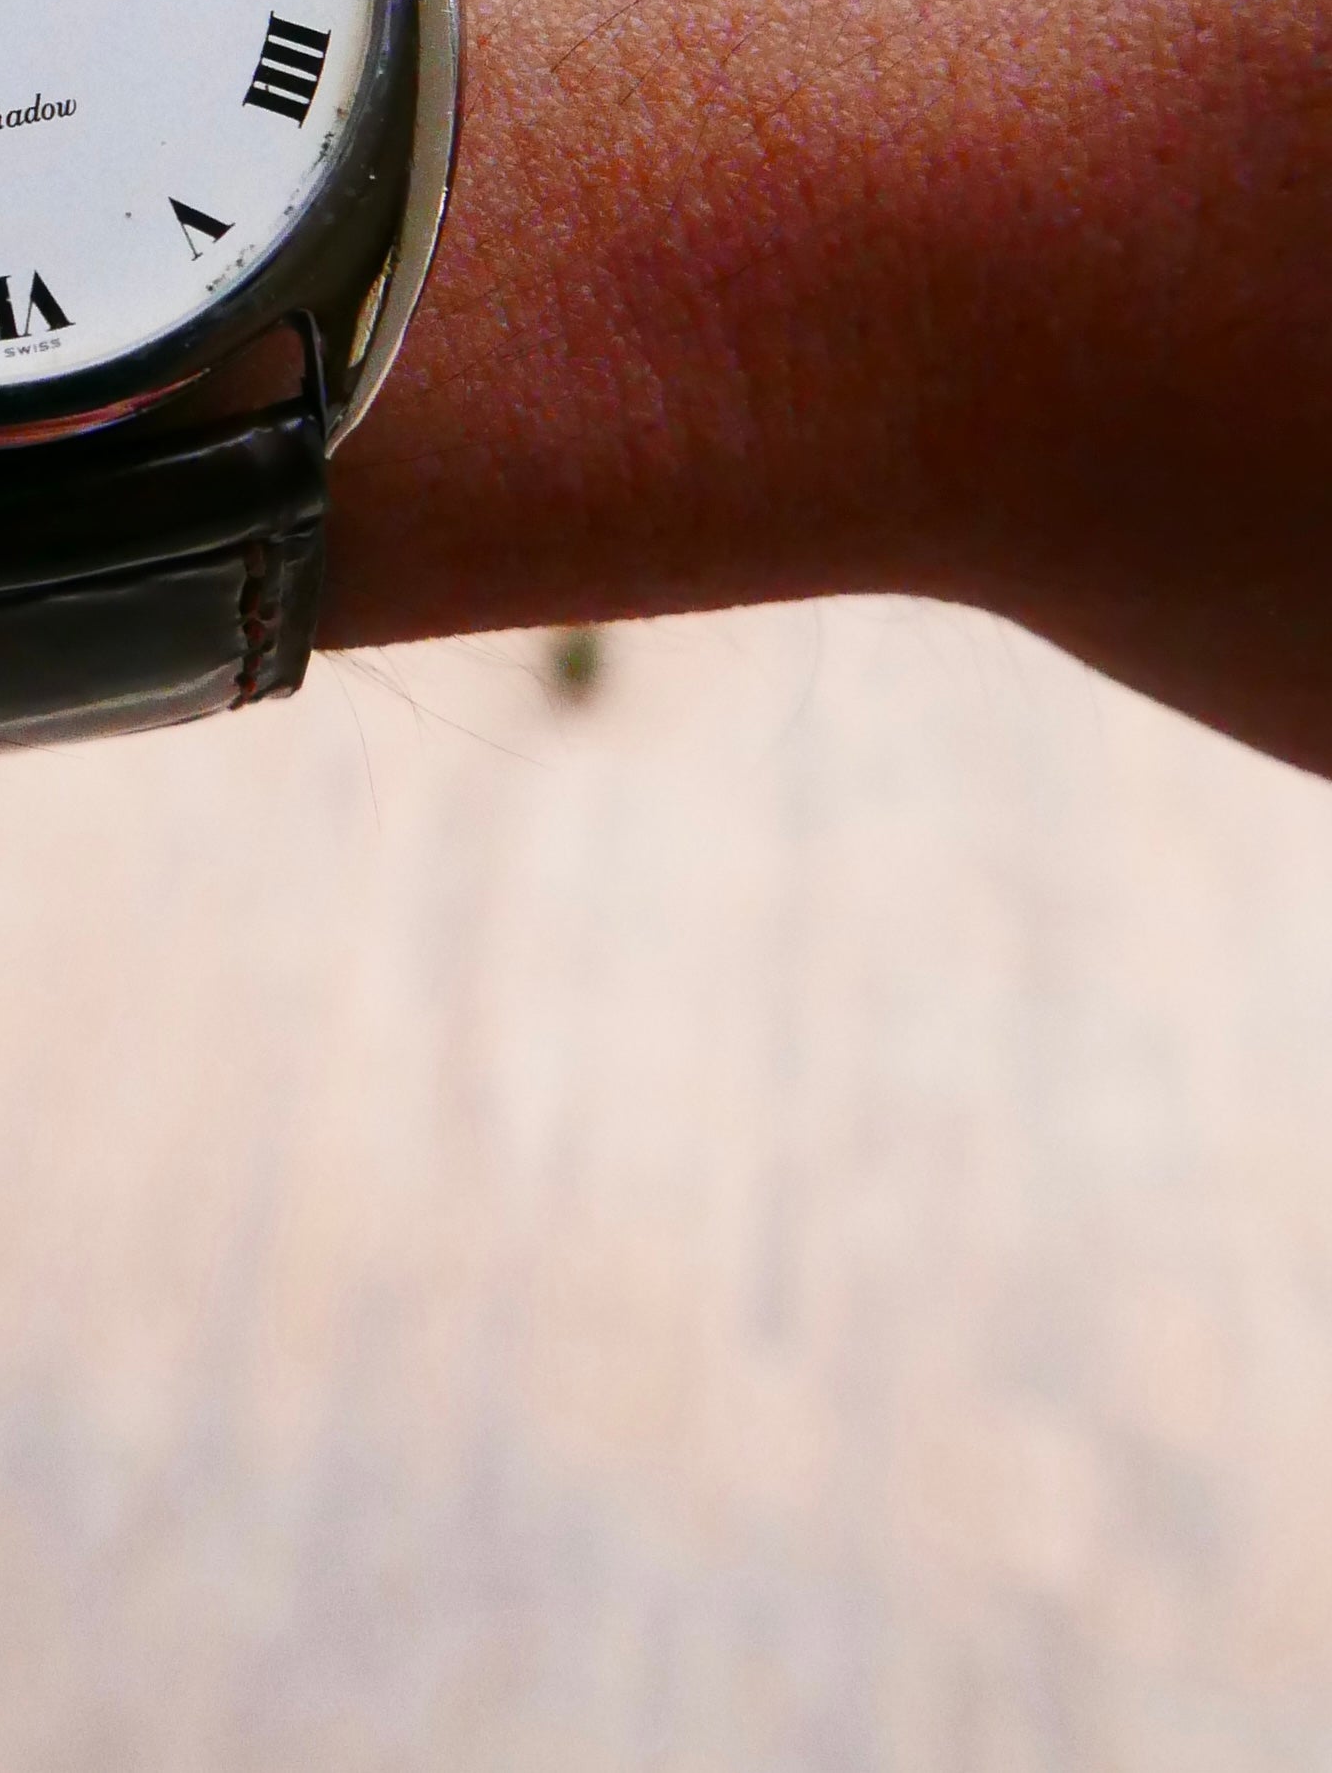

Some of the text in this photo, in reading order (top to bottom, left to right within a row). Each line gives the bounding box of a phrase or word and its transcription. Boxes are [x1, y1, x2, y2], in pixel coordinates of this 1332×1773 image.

[242, 11, 332, 128] IIII
[167, 195, 236, 262] V
[4, 338, 62, 358] SWISS
